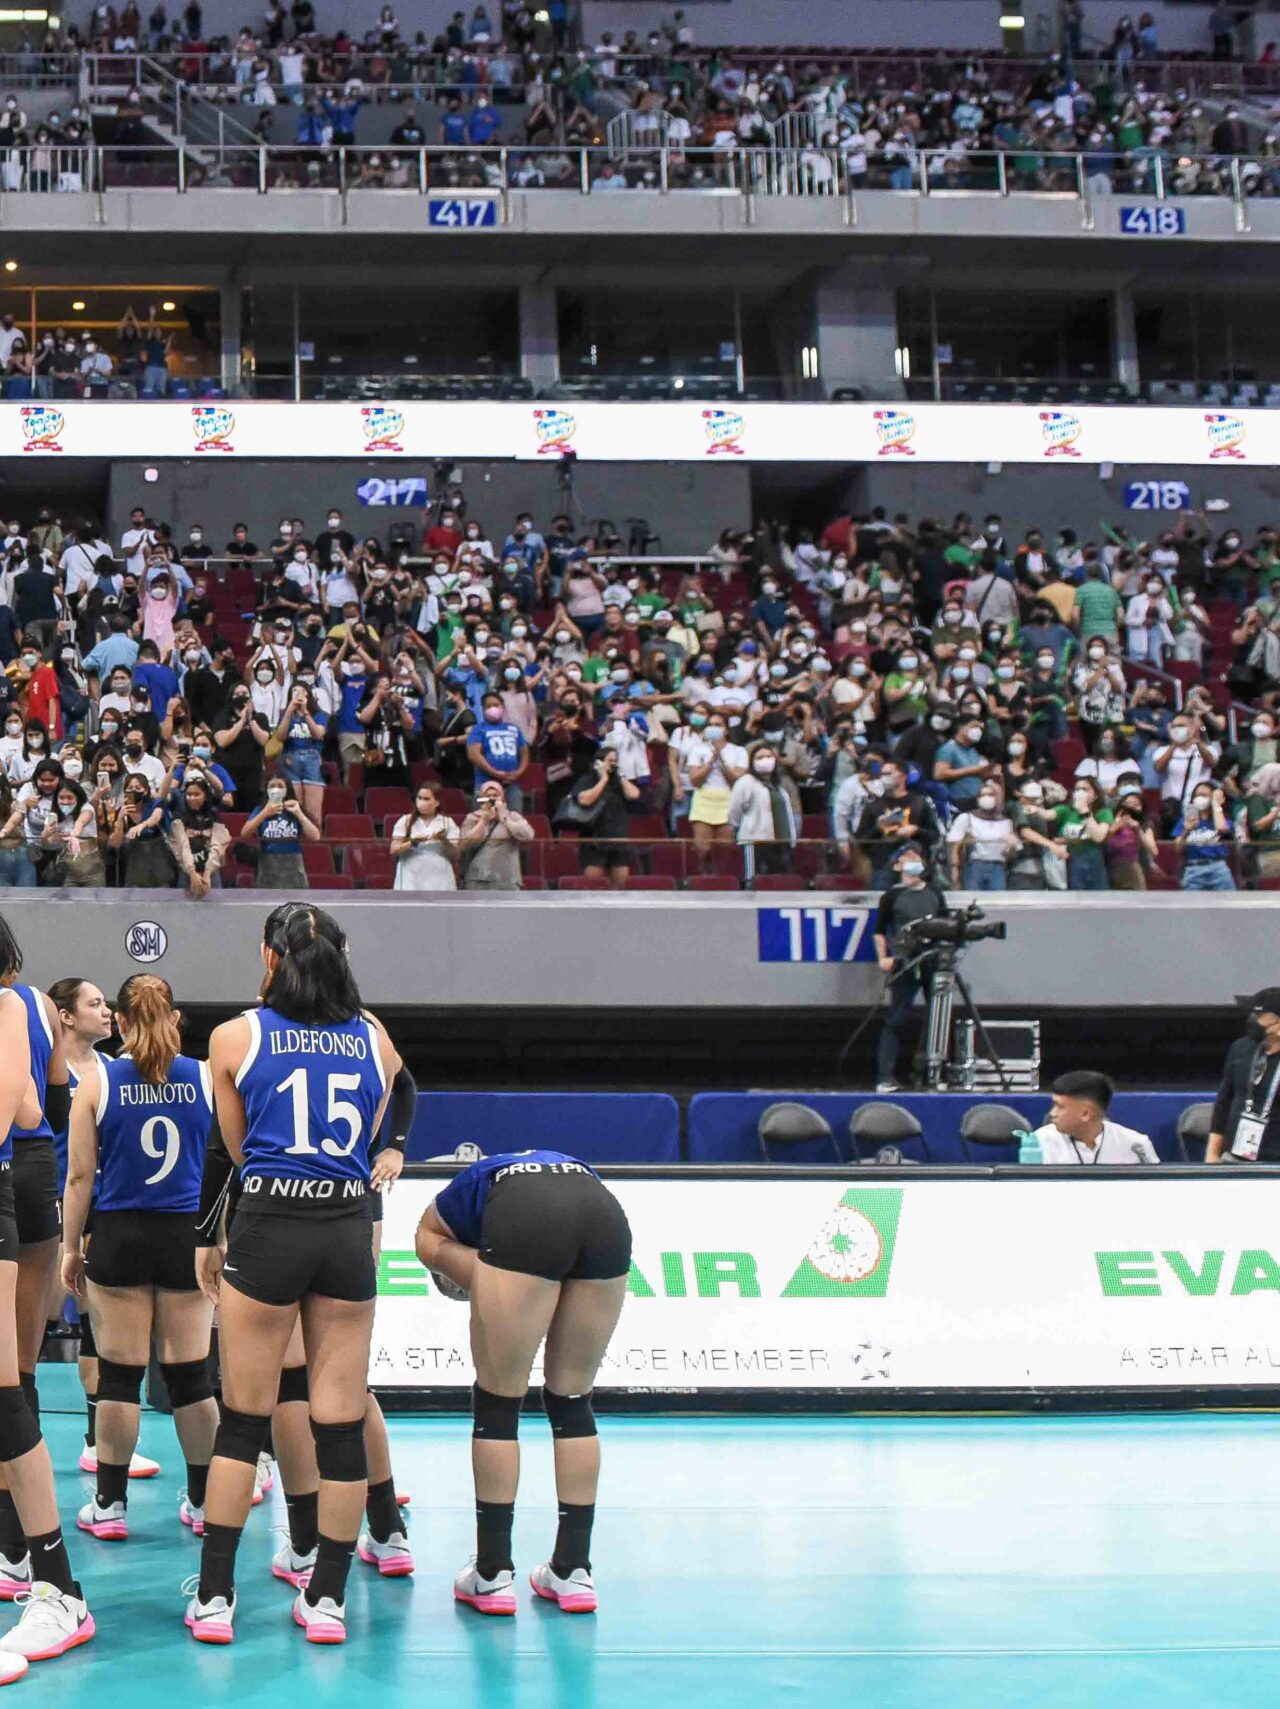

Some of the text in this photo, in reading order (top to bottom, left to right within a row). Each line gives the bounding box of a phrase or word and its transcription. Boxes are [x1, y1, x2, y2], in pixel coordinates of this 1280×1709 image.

[435, 200, 489, 226] 417
[1125, 208, 1180, 233] 418
[368, 479, 421, 506] 217
[1129, 482, 1183, 509] 218
[780, 909, 869, 960] 117
[270, 1029, 366, 1060] ILDEFONSO
[120, 1083, 196, 1105] FUJIMOTO
[276, 1068, 362, 1157] 15
[141, 1116, 180, 1185] 9
[496, 1163, 542, 1182] PRO
[1094, 1250, 1280, 1296] EVA
[375, 1348, 393, 1368] A
[406, 1348, 465, 1369] STA
[683, 1349, 830, 1370] MEMBER
[1120, 1347, 1138, 1368] A
[1148, 1347, 1229, 1369] STAR
